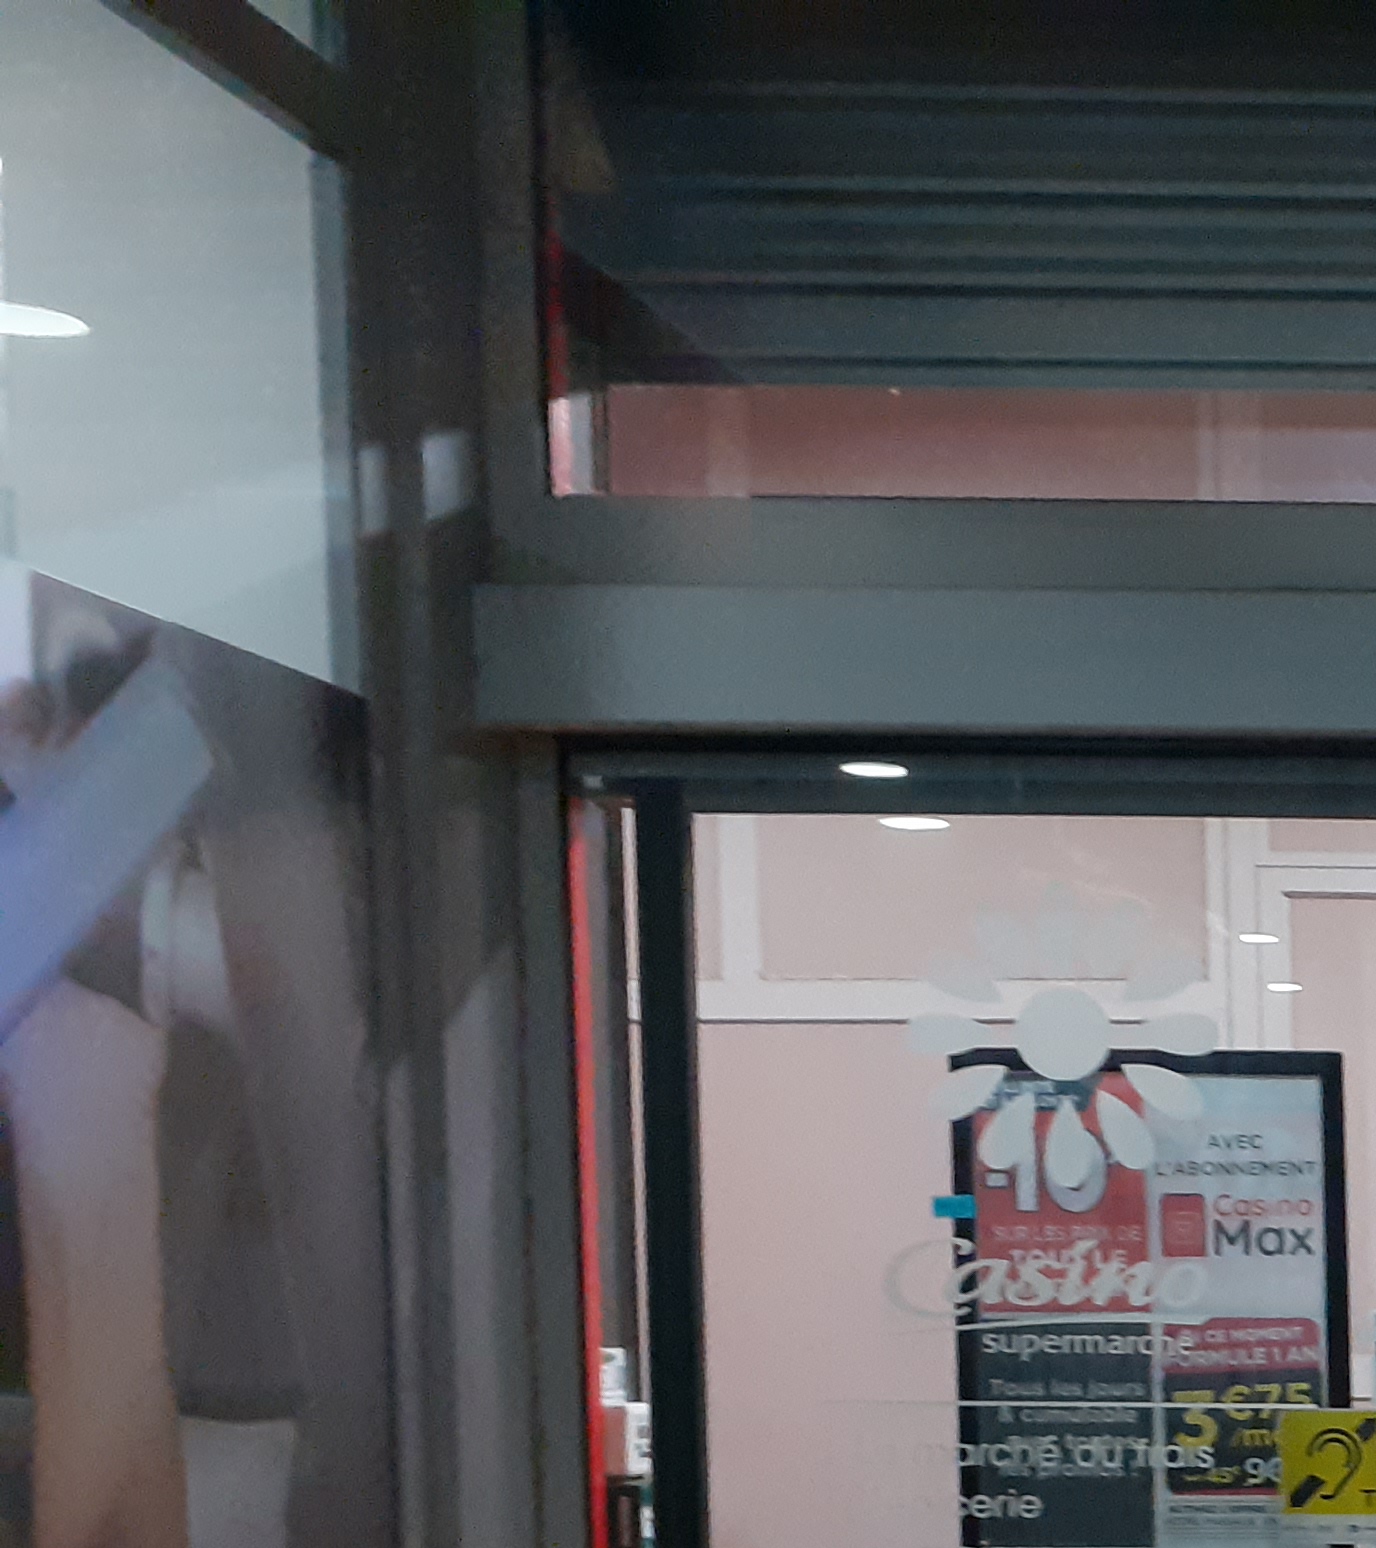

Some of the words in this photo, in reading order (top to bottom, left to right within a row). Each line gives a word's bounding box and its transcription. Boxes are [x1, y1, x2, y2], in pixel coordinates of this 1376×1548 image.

[1207, 1133, 1264, 1150] AVEC
[1213, 1218, 1317, 1257] Max
[981, 1331, 1195, 1362] supermarché
